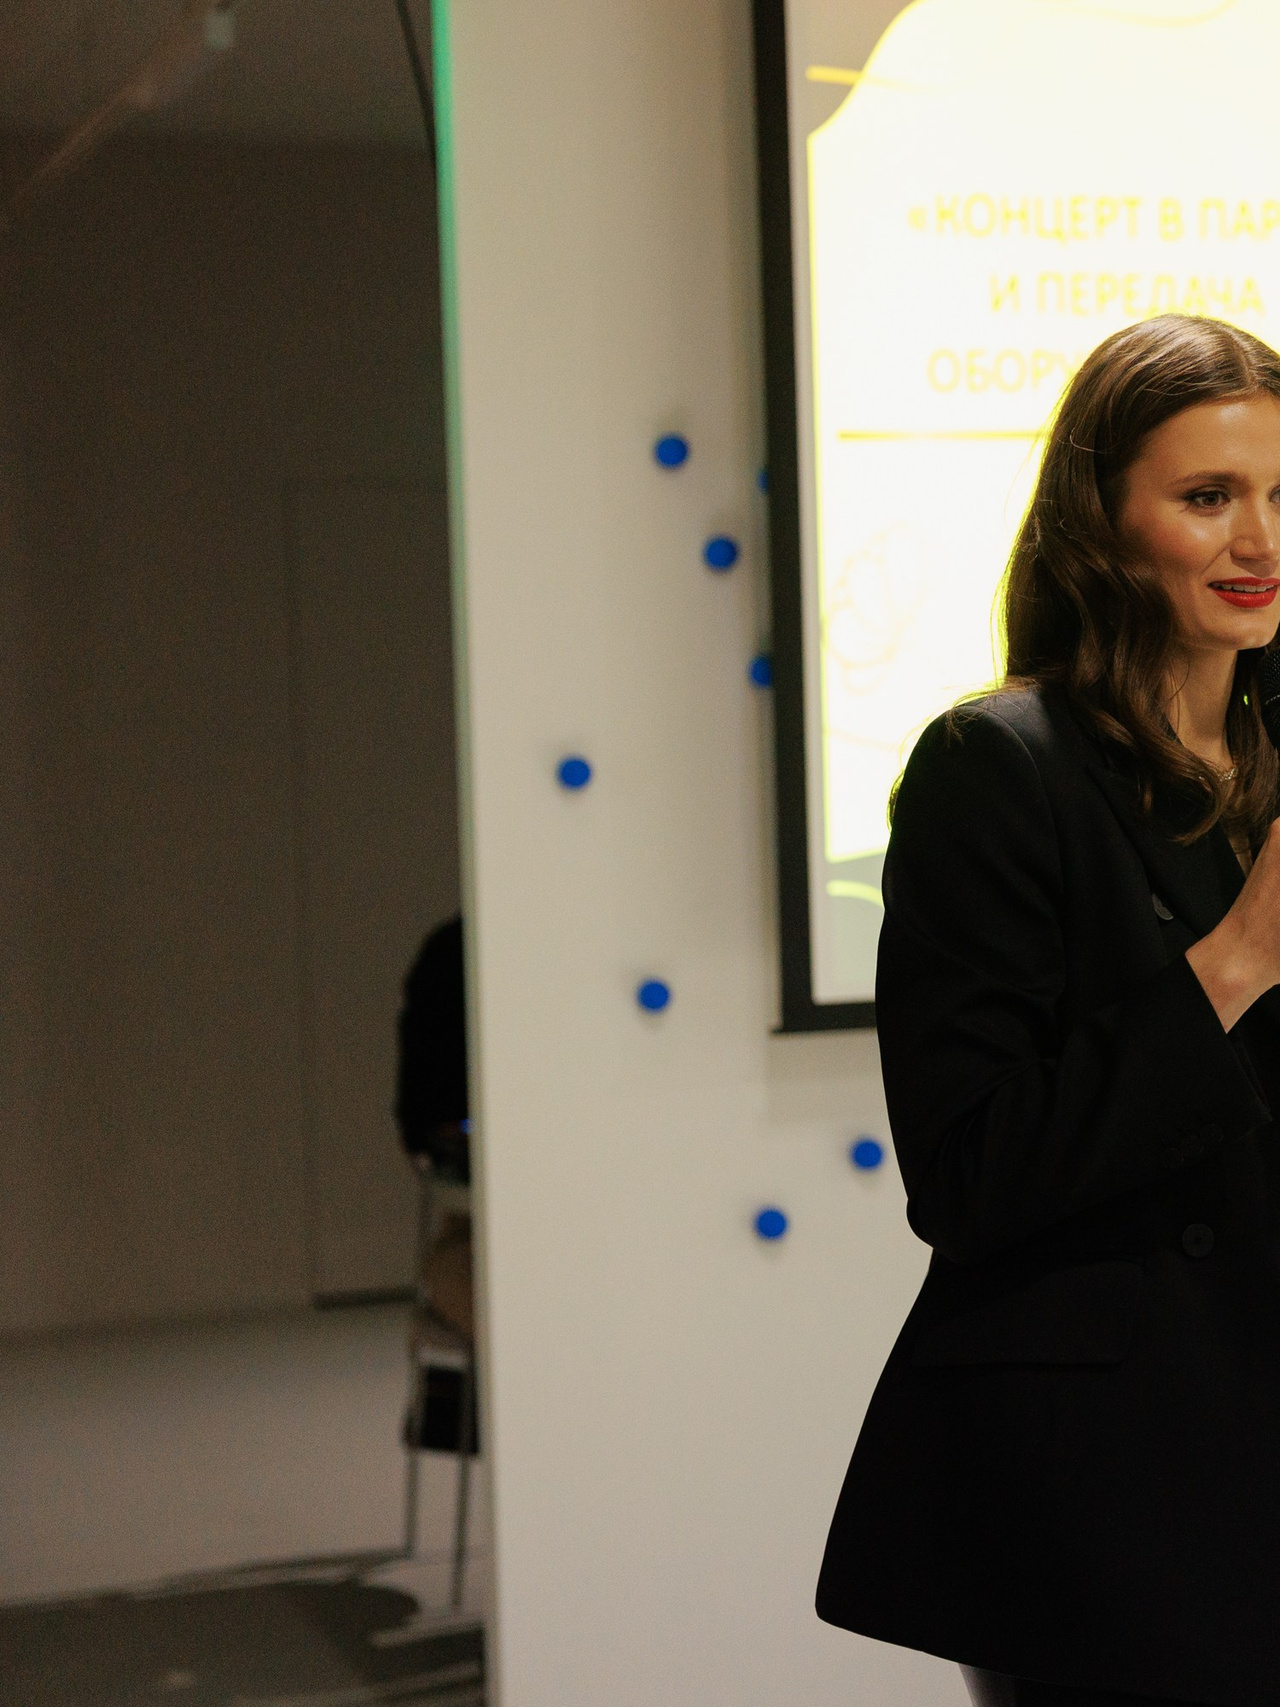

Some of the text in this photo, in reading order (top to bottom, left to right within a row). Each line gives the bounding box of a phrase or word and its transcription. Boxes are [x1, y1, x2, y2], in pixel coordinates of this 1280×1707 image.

[909, 194, 1142, 244] «КОНЦЕРТ
[1157, 197, 1186, 241] В
[988, 273, 1266, 317] И ПЕРЕДАЧА
